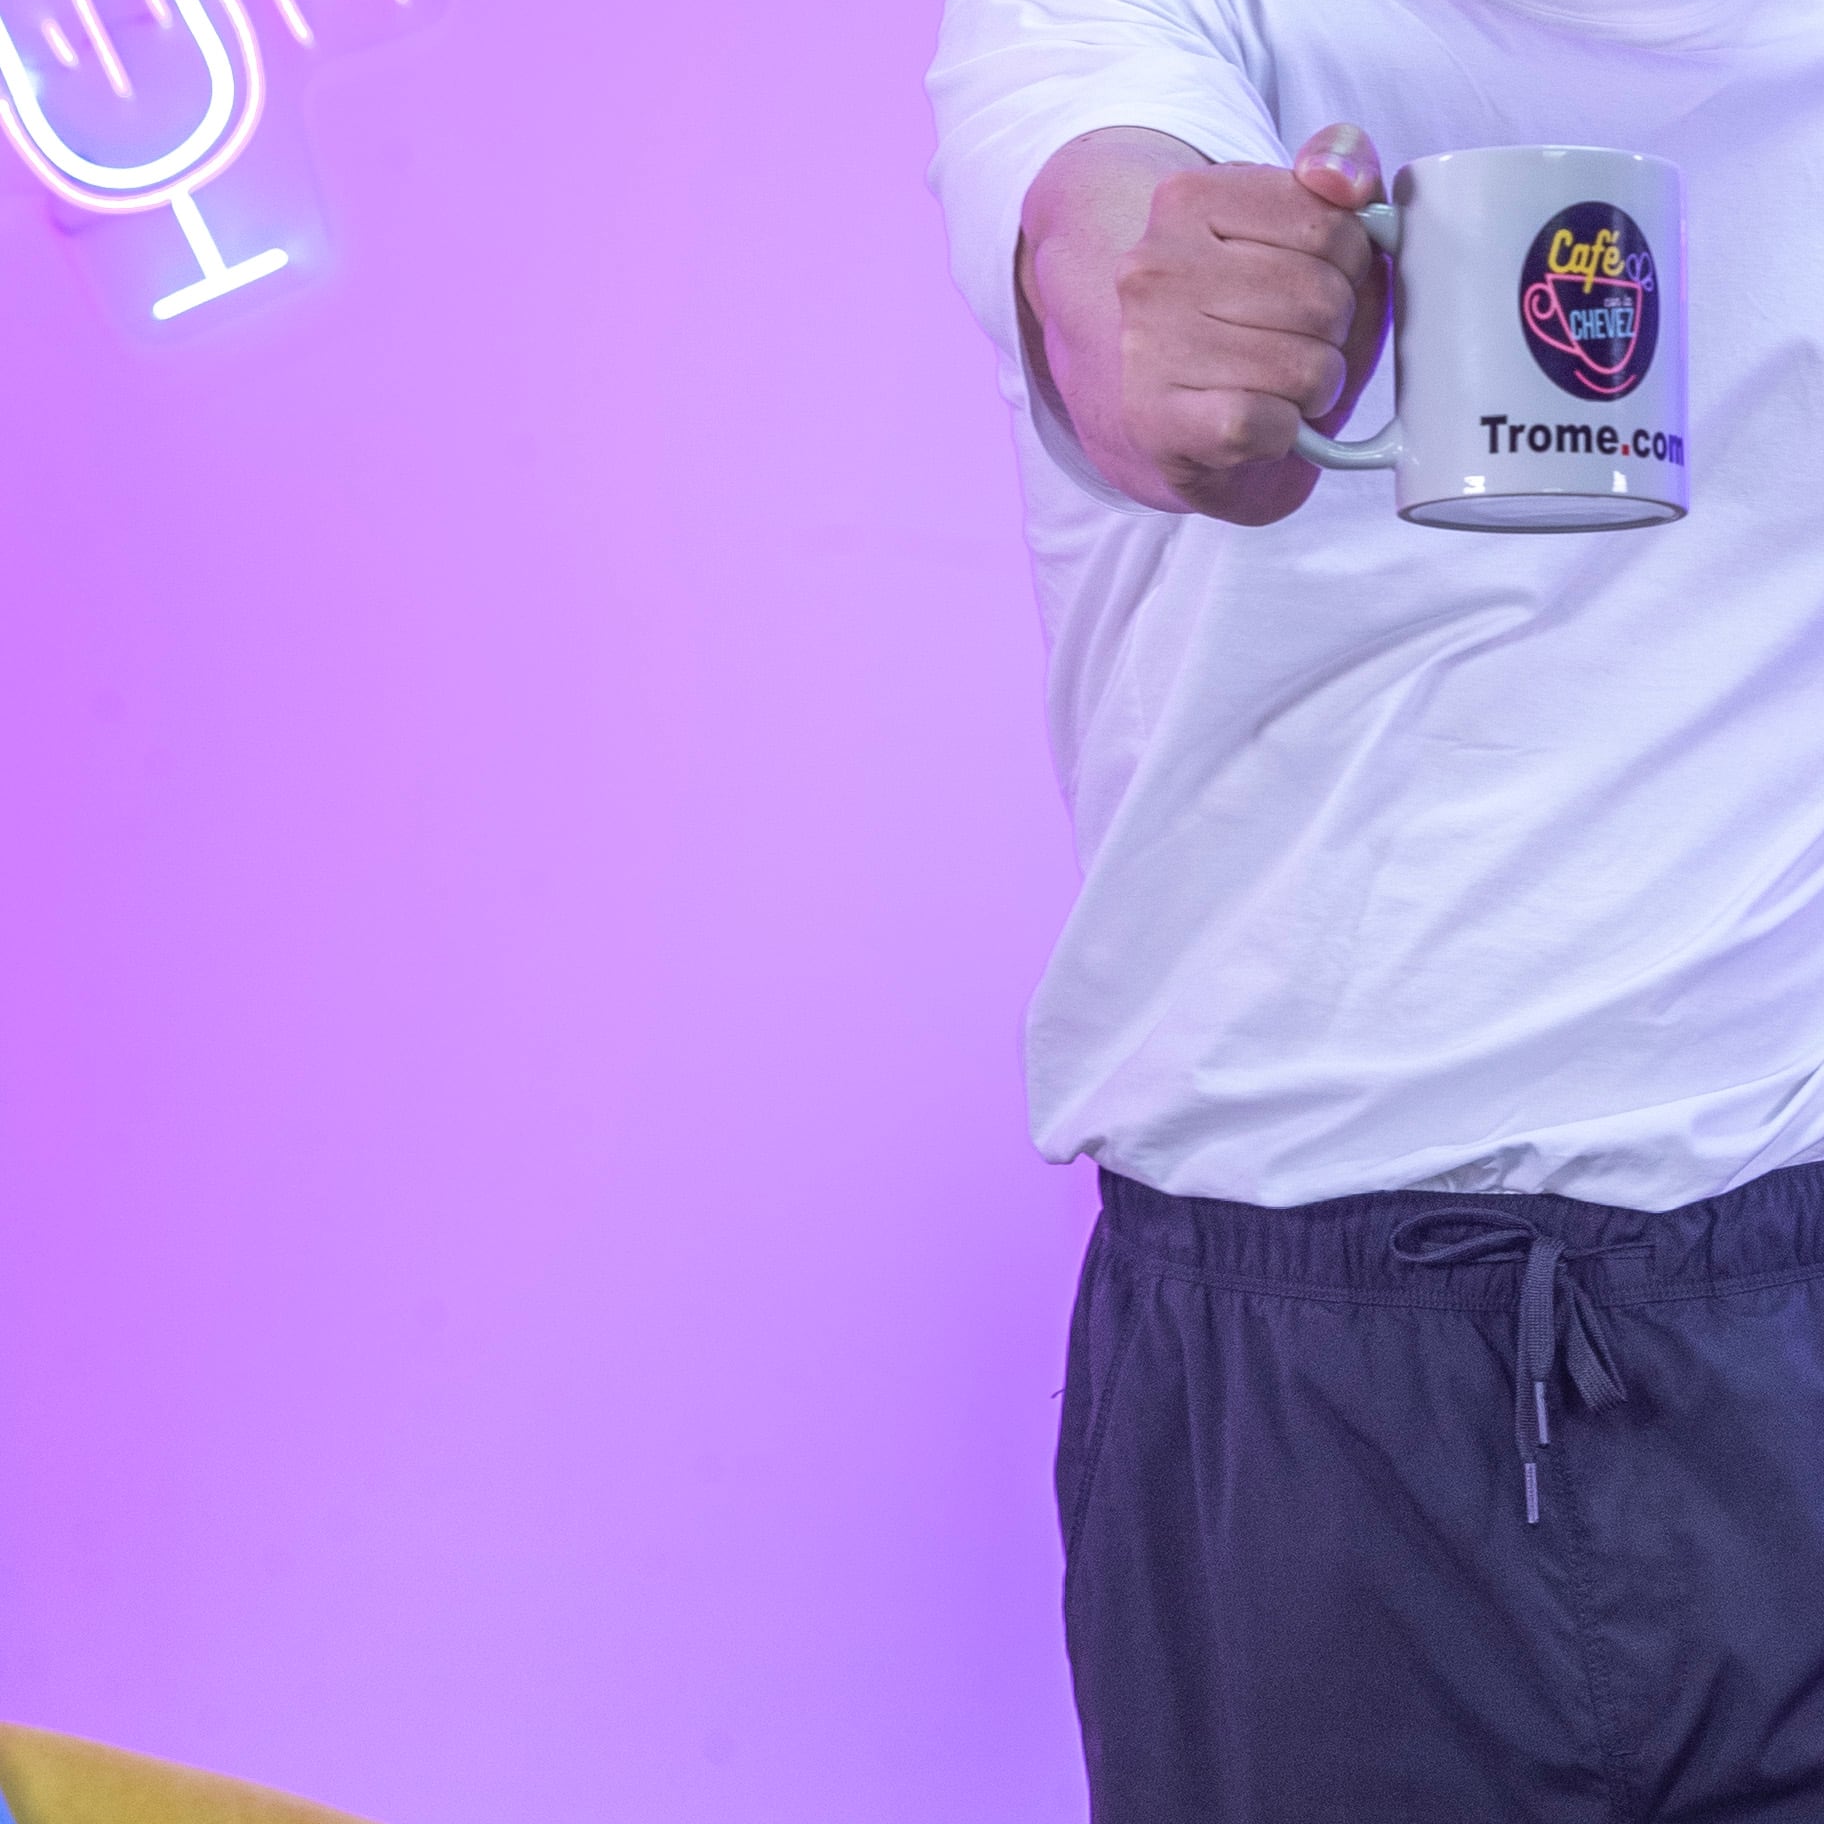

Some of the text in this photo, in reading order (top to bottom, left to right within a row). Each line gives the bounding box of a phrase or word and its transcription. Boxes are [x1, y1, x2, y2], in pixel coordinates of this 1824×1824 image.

[1548, 228, 1625, 294] Café
[1569, 308, 1634, 340] CHEVEZ
[1481, 414, 1685, 467] Trome.com
